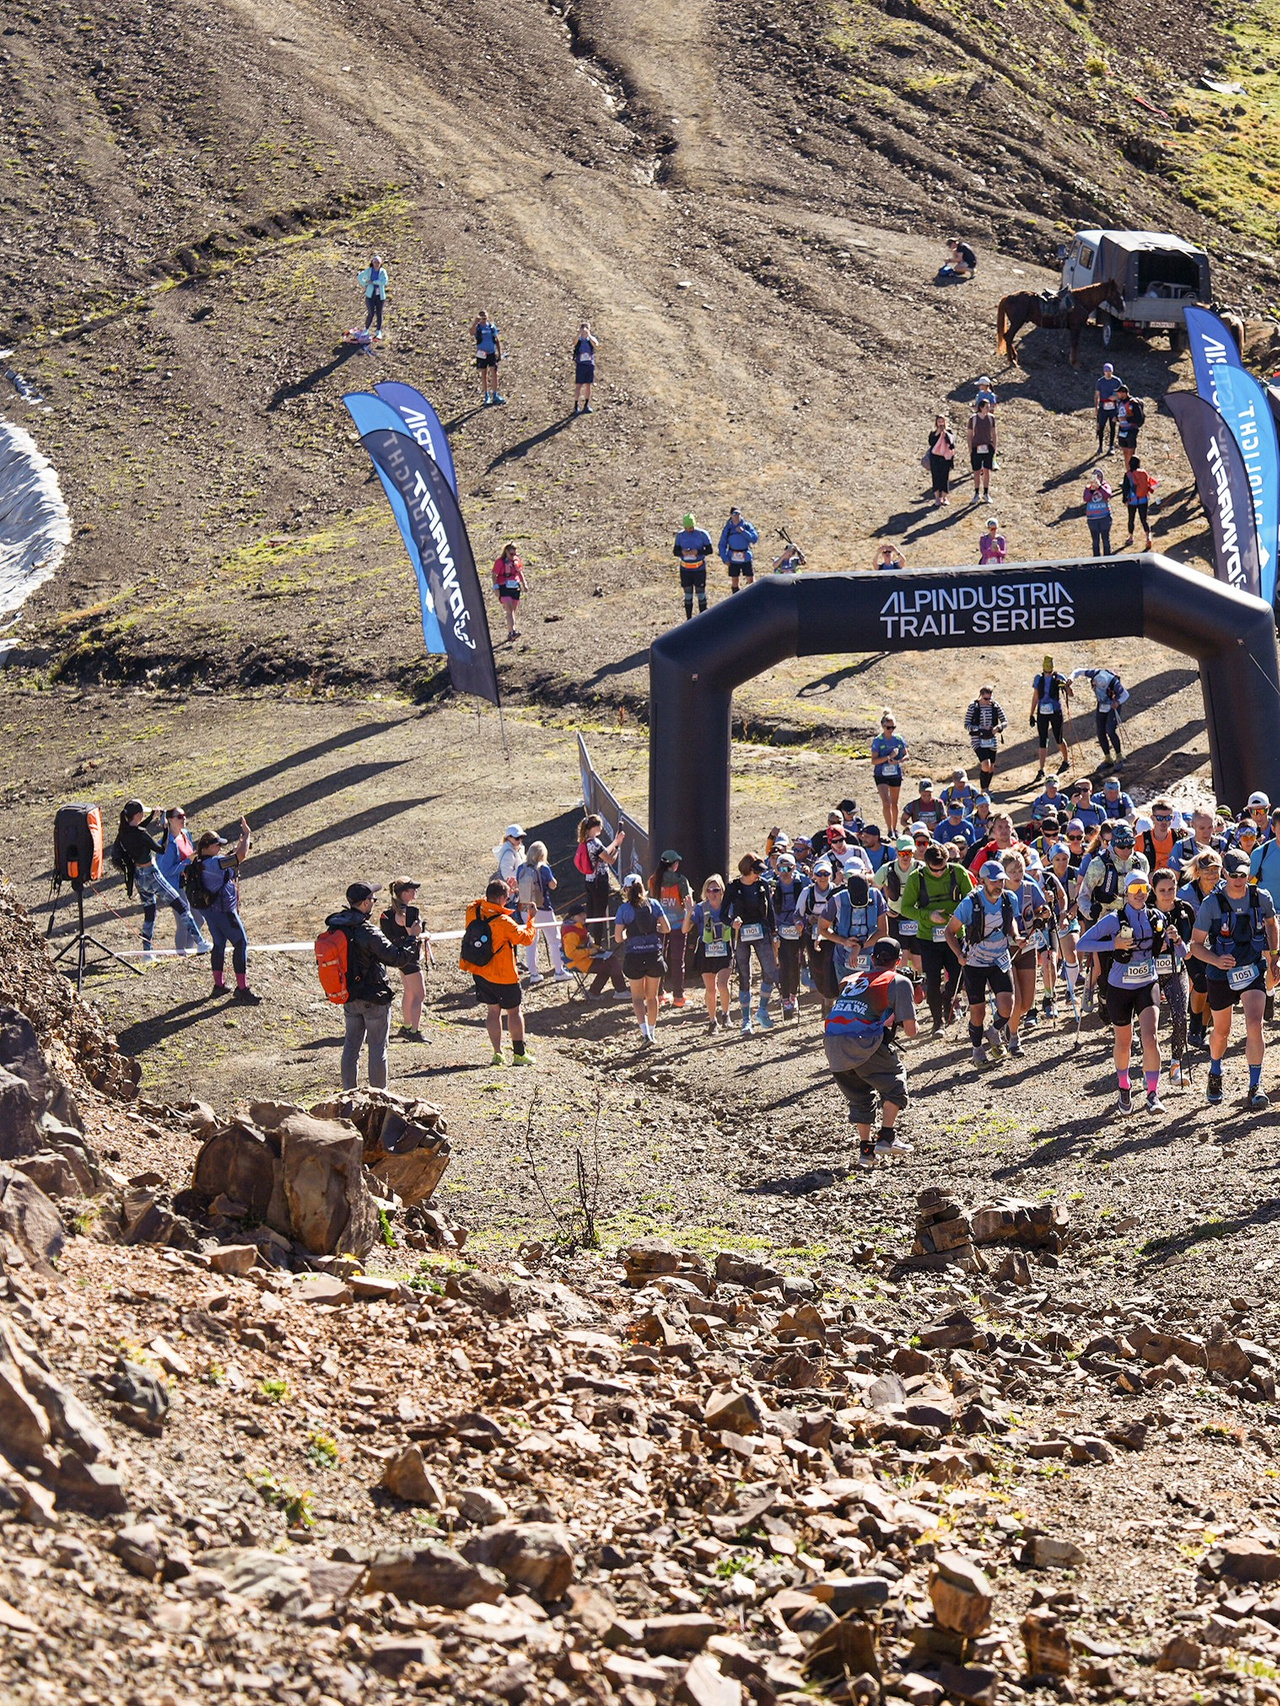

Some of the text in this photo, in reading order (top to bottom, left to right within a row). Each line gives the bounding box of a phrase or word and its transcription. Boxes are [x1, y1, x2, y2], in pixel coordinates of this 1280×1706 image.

[880, 581, 1074, 614] ALPINDUSTRIA
[880, 606, 1076, 639] TRAIL SERIES
[1129, 965, 1148, 974] 1065
[1234, 970, 1252, 980] 1051
